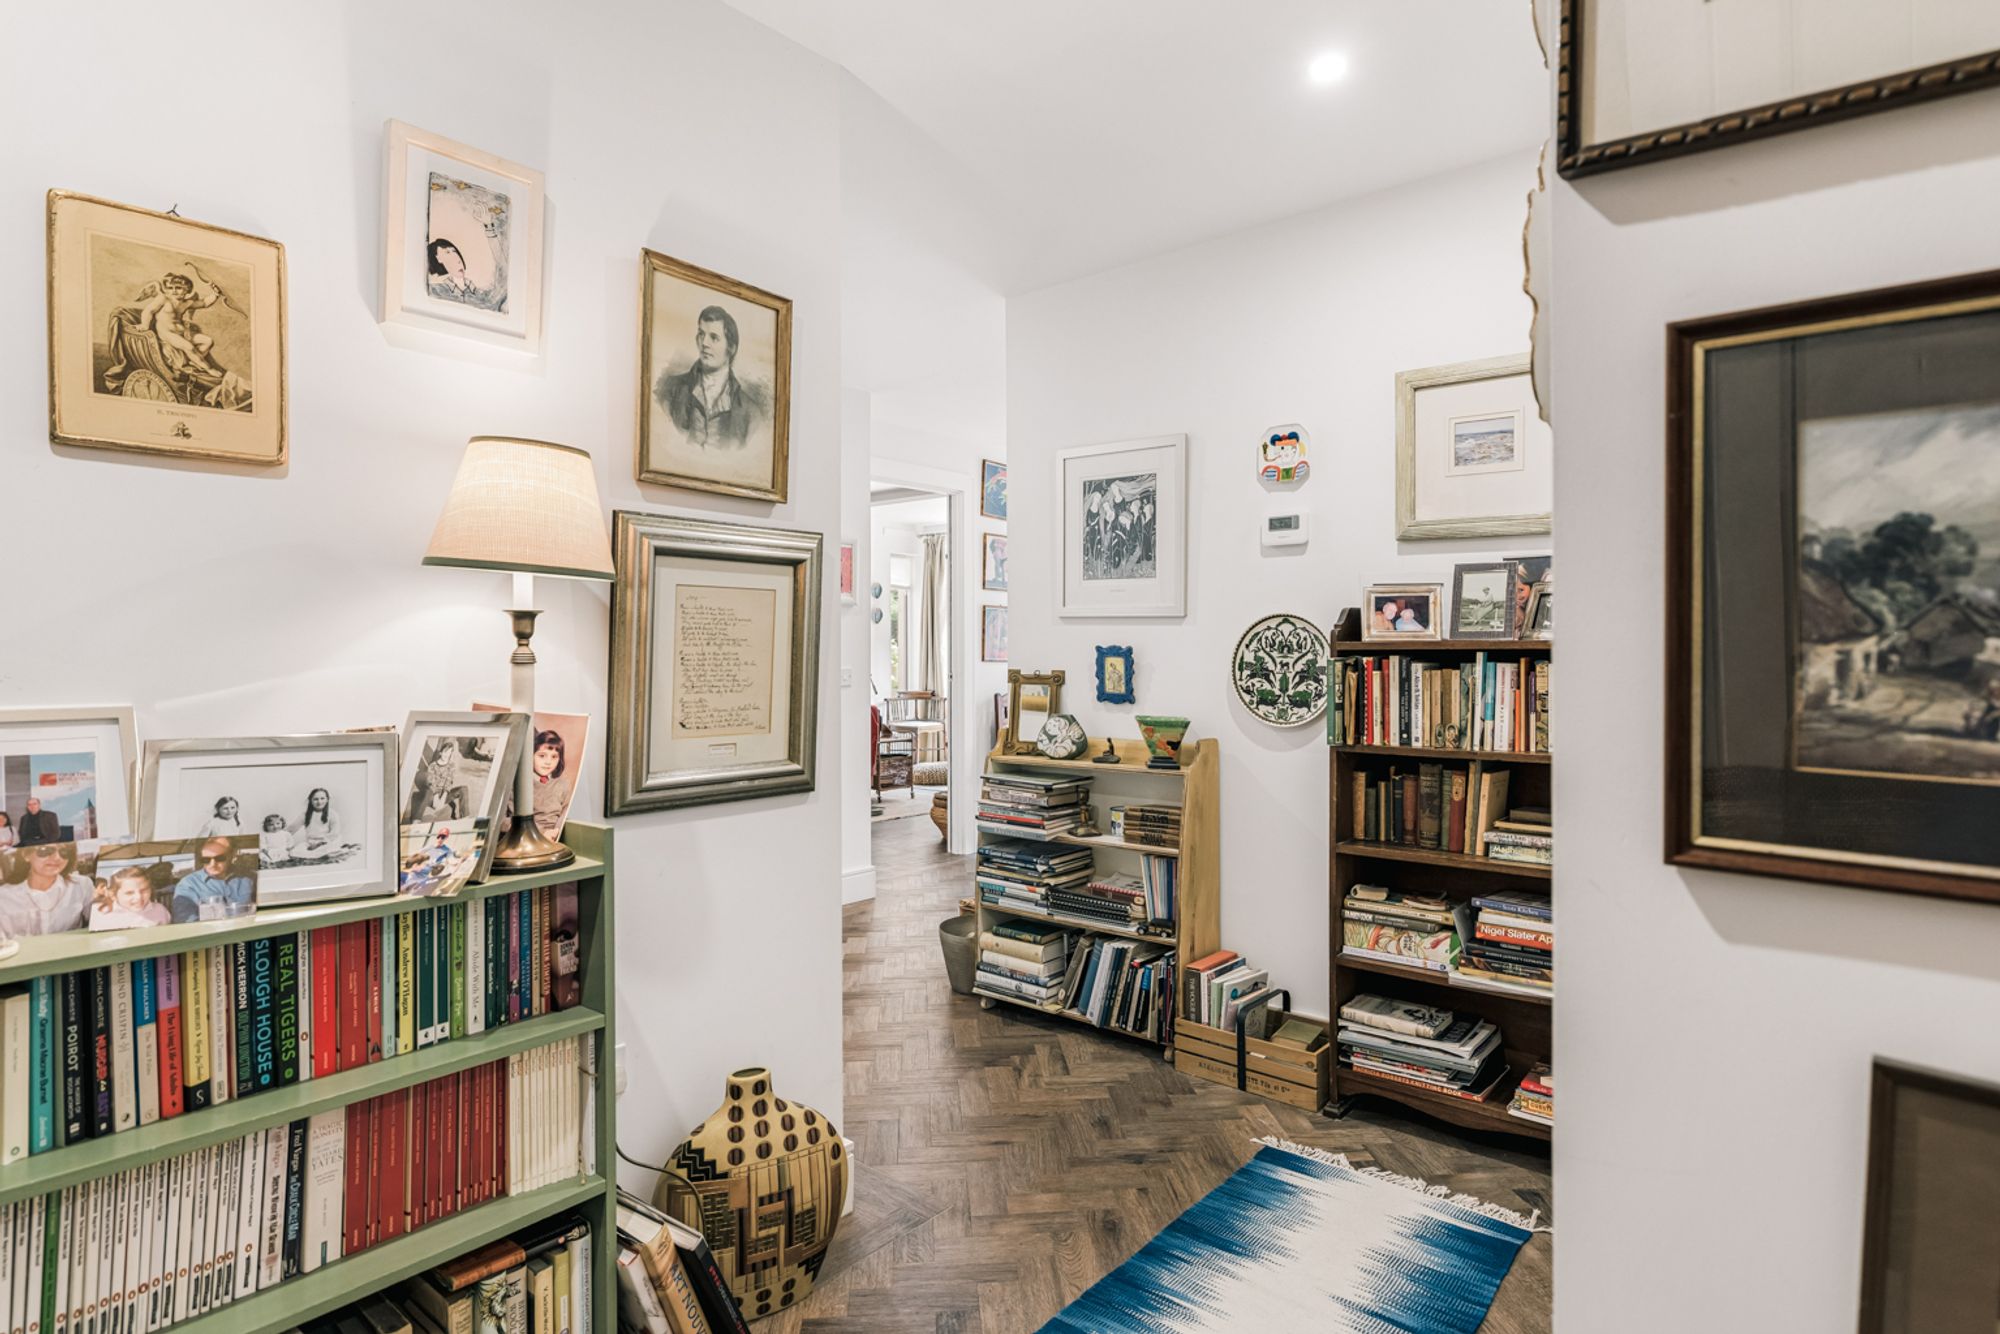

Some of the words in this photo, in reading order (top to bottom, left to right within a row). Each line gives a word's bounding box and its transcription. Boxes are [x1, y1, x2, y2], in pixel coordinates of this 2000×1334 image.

[1481, 924, 1505, 937] Nigel
[1507, 929, 1536, 940] Slater
[255, 940, 270, 1009] SLOUGH
[280, 943, 294, 992] REAL
[402, 947, 410, 978] Andrew
[117, 962, 126, 999] DMUND
[238, 966, 248, 1009] HERRON
[472, 974, 480, 994] With
[402, 980, 411, 1016] O'Hagan
[472, 997, 480, 1008] Me
[257, 1014, 272, 1074] HOUSE
[280, 994, 296, 1062] TIGERS
[67, 1024, 78, 1072] POIROT
[1443, 1087, 1462, 1096] BOOK
[294, 1128, 304, 1147] Fred
[292, 1148, 301, 1171] Vargas
[671, 1263, 689, 1293] ART
